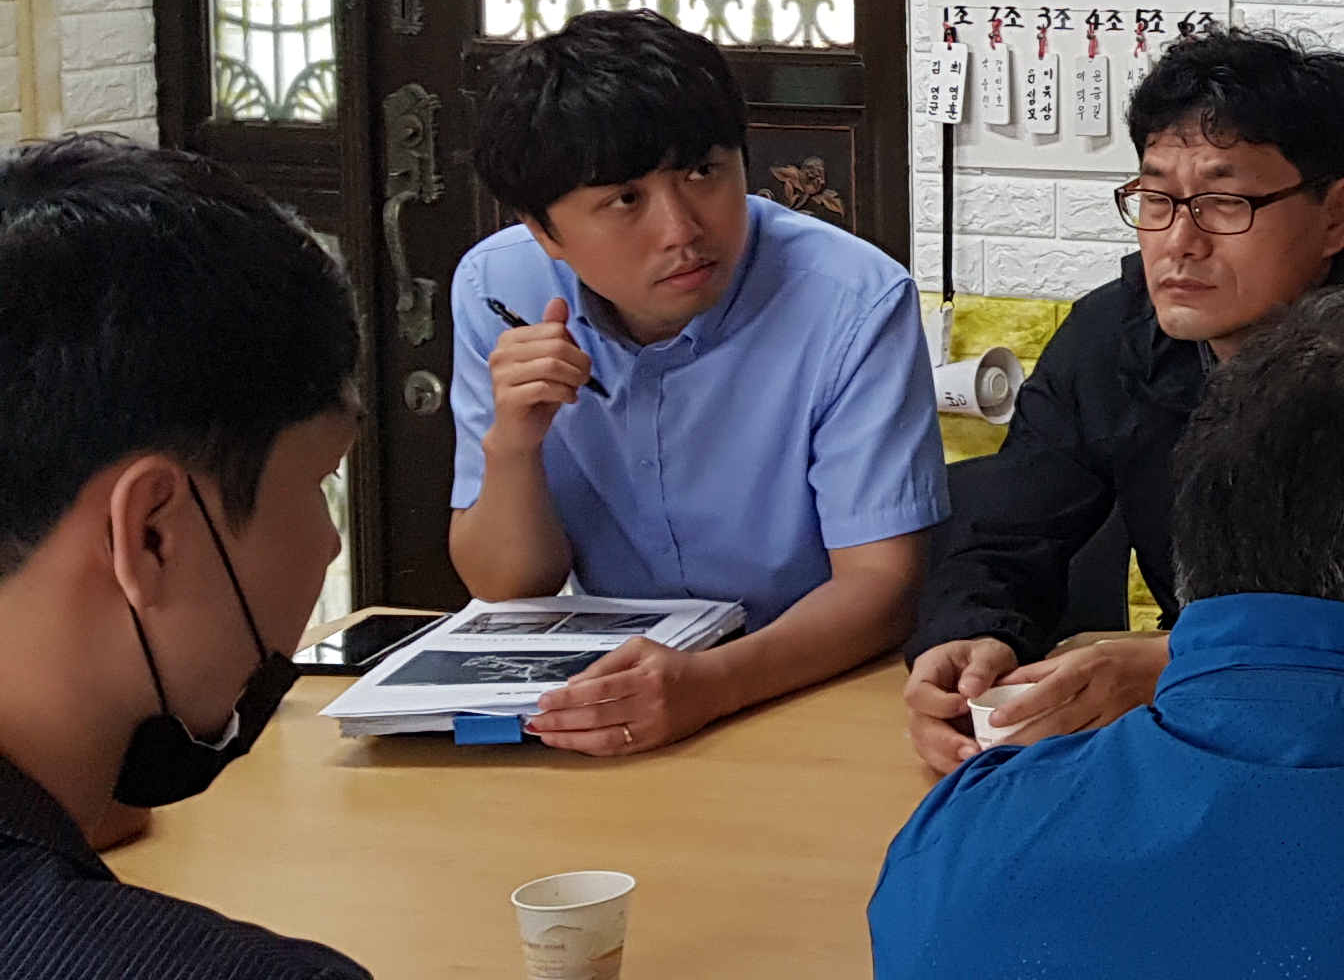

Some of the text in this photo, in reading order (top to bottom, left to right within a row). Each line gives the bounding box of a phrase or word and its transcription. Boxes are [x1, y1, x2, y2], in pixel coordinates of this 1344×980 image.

[943, 5, 974, 25] 1조
[988, 5, 1025, 28] 2조
[1036, 6, 1075, 31] 3조
[1085, 8, 1125, 32] 4조
[1134, 8, 1166, 33] 5조
